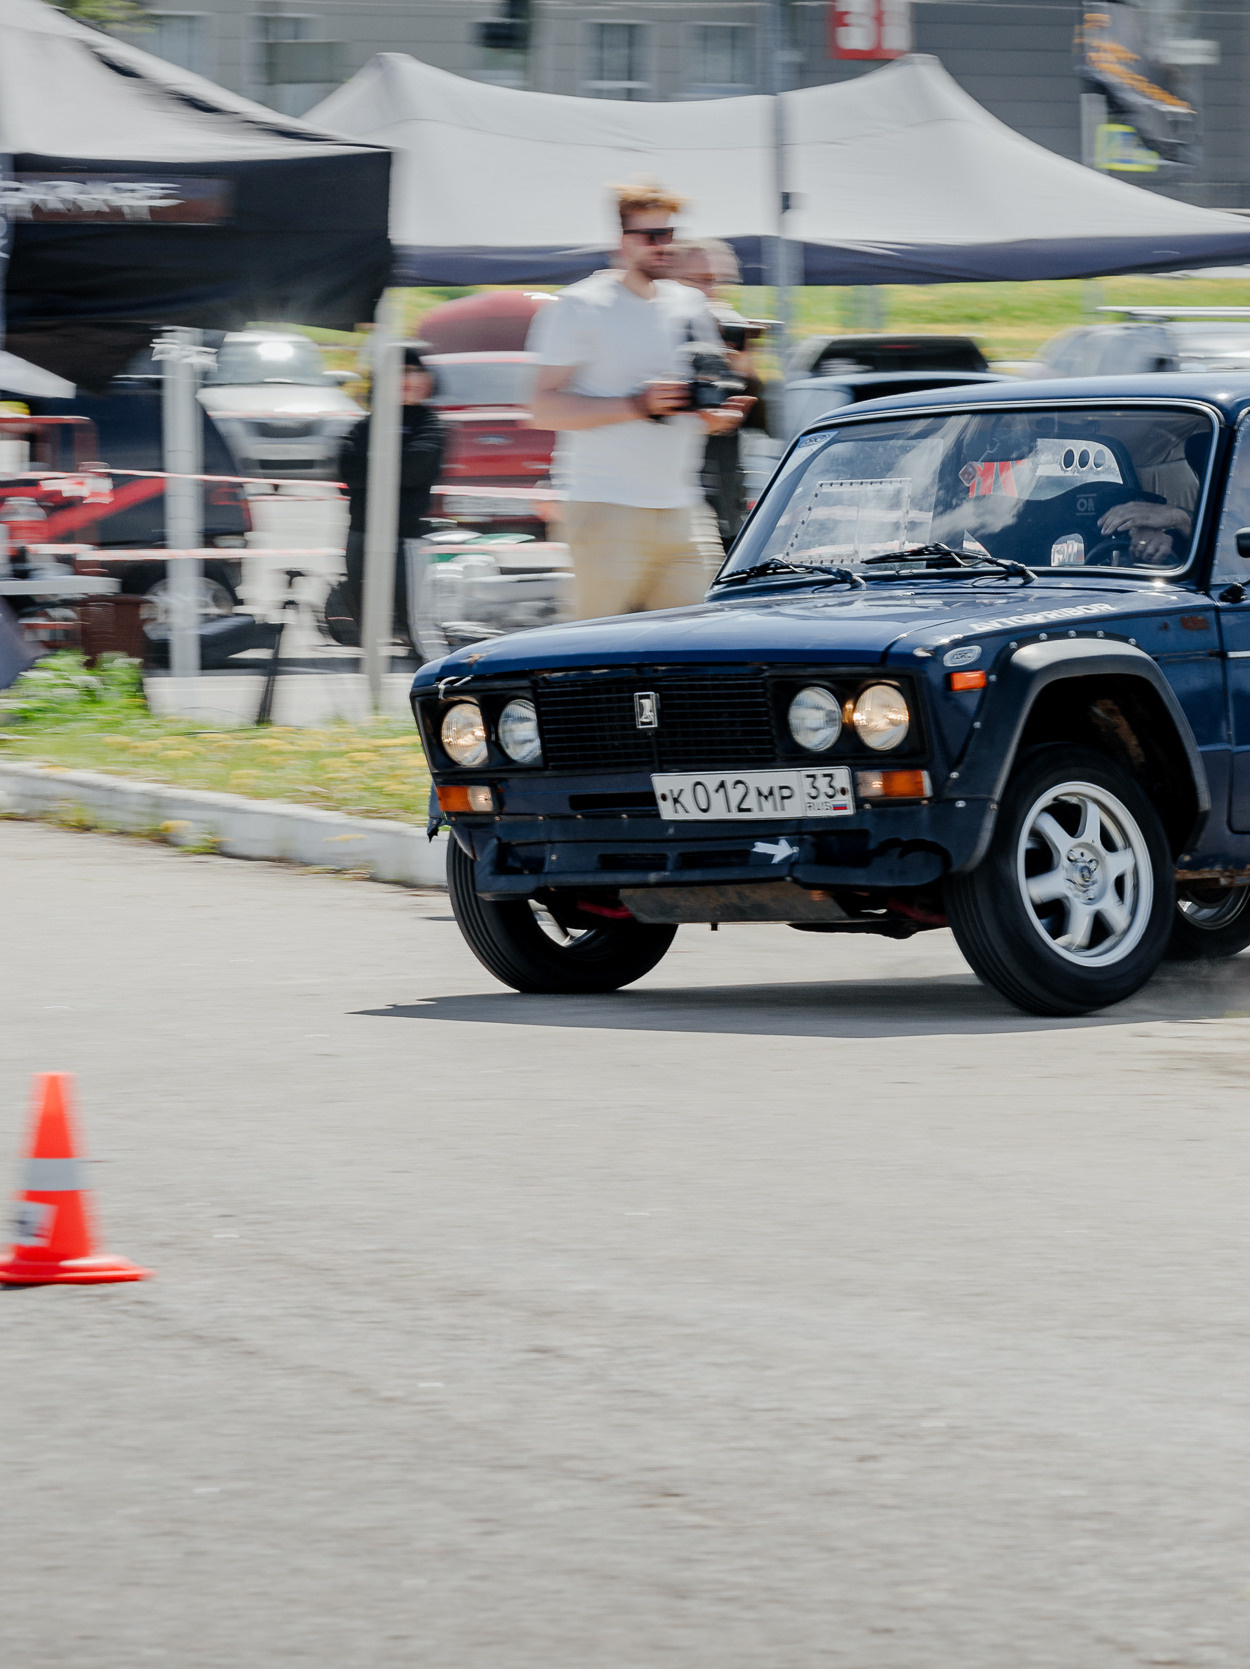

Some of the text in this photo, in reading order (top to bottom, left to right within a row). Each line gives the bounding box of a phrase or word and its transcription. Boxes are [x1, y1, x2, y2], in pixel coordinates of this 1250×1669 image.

[968, 603, 1118, 632] AVTOPRIBOR
[805, 773, 837, 799] 33
[806, 801, 832, 811] RUS
